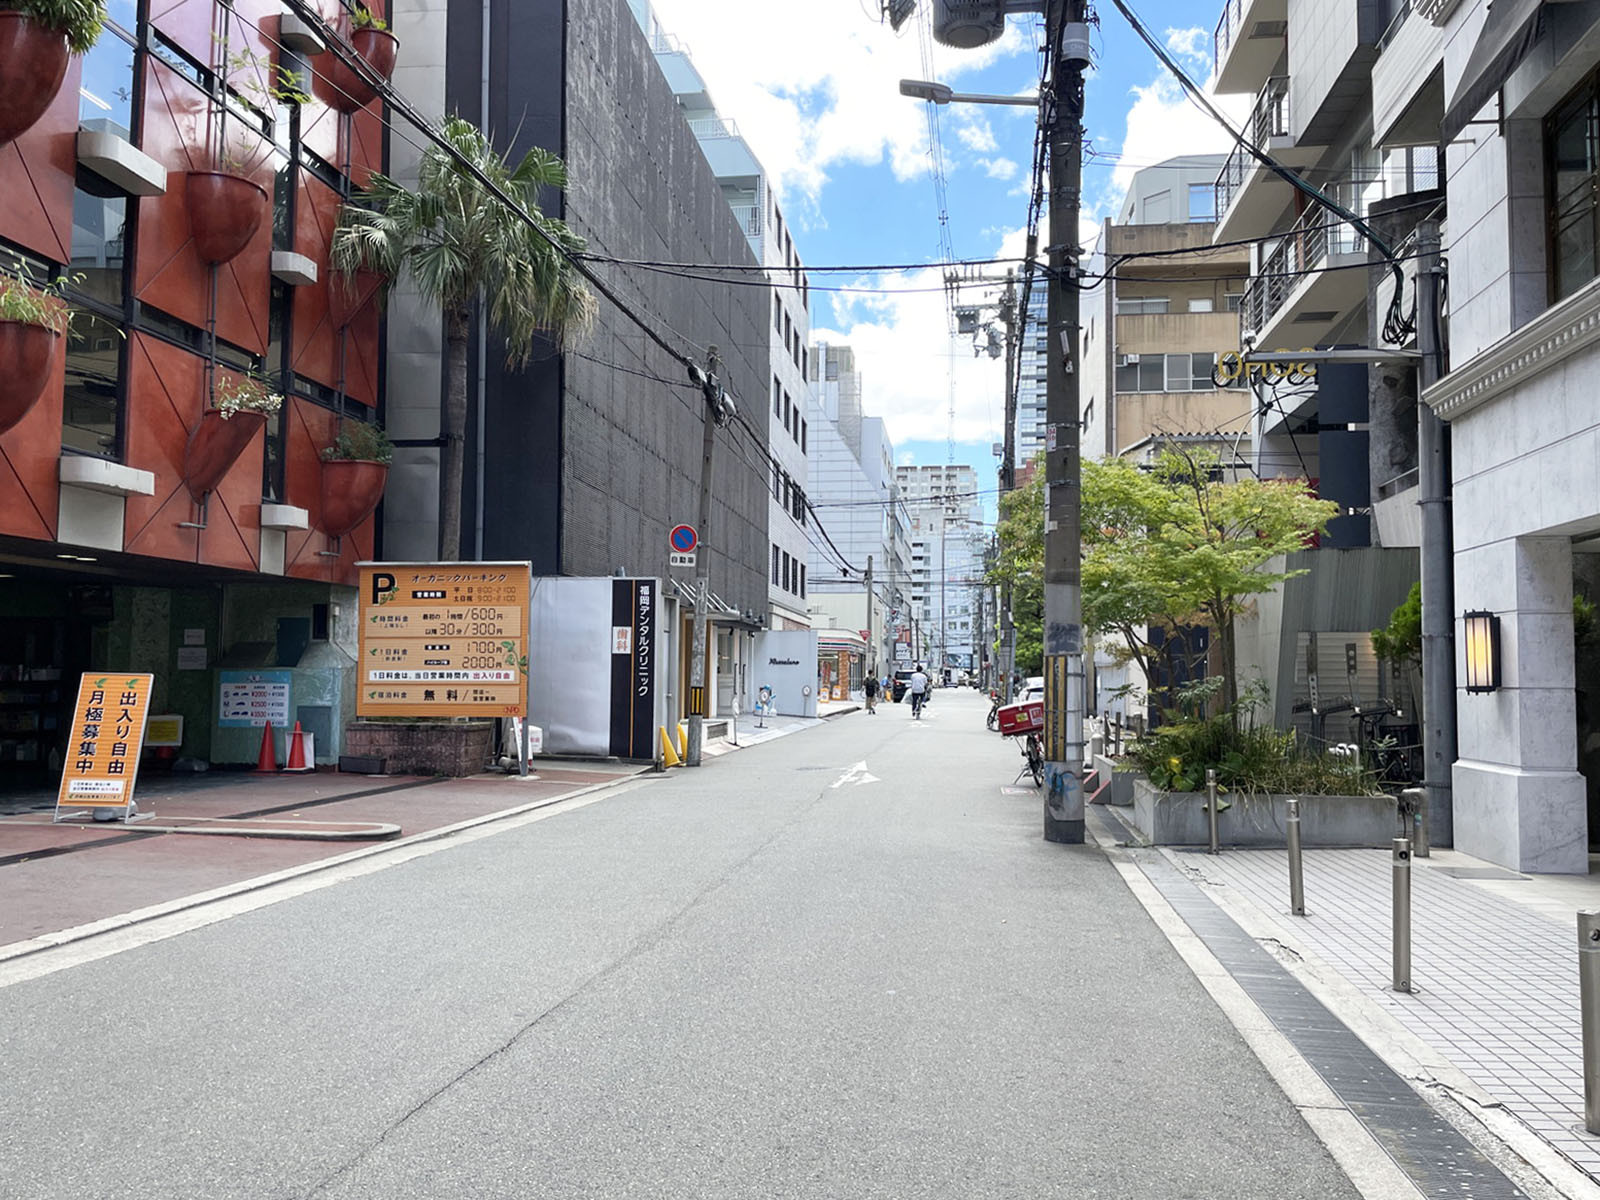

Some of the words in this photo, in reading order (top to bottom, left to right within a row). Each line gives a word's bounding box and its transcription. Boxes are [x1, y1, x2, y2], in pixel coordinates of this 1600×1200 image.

[372, 573, 396, 605] P
[616, 628, 628, 652] 歯科
[638, 585, 650, 696] 福岡デンタルクリニック
[76, 690, 105, 774] 月極募集中
[108, 691, 137, 774] 出入り自由
